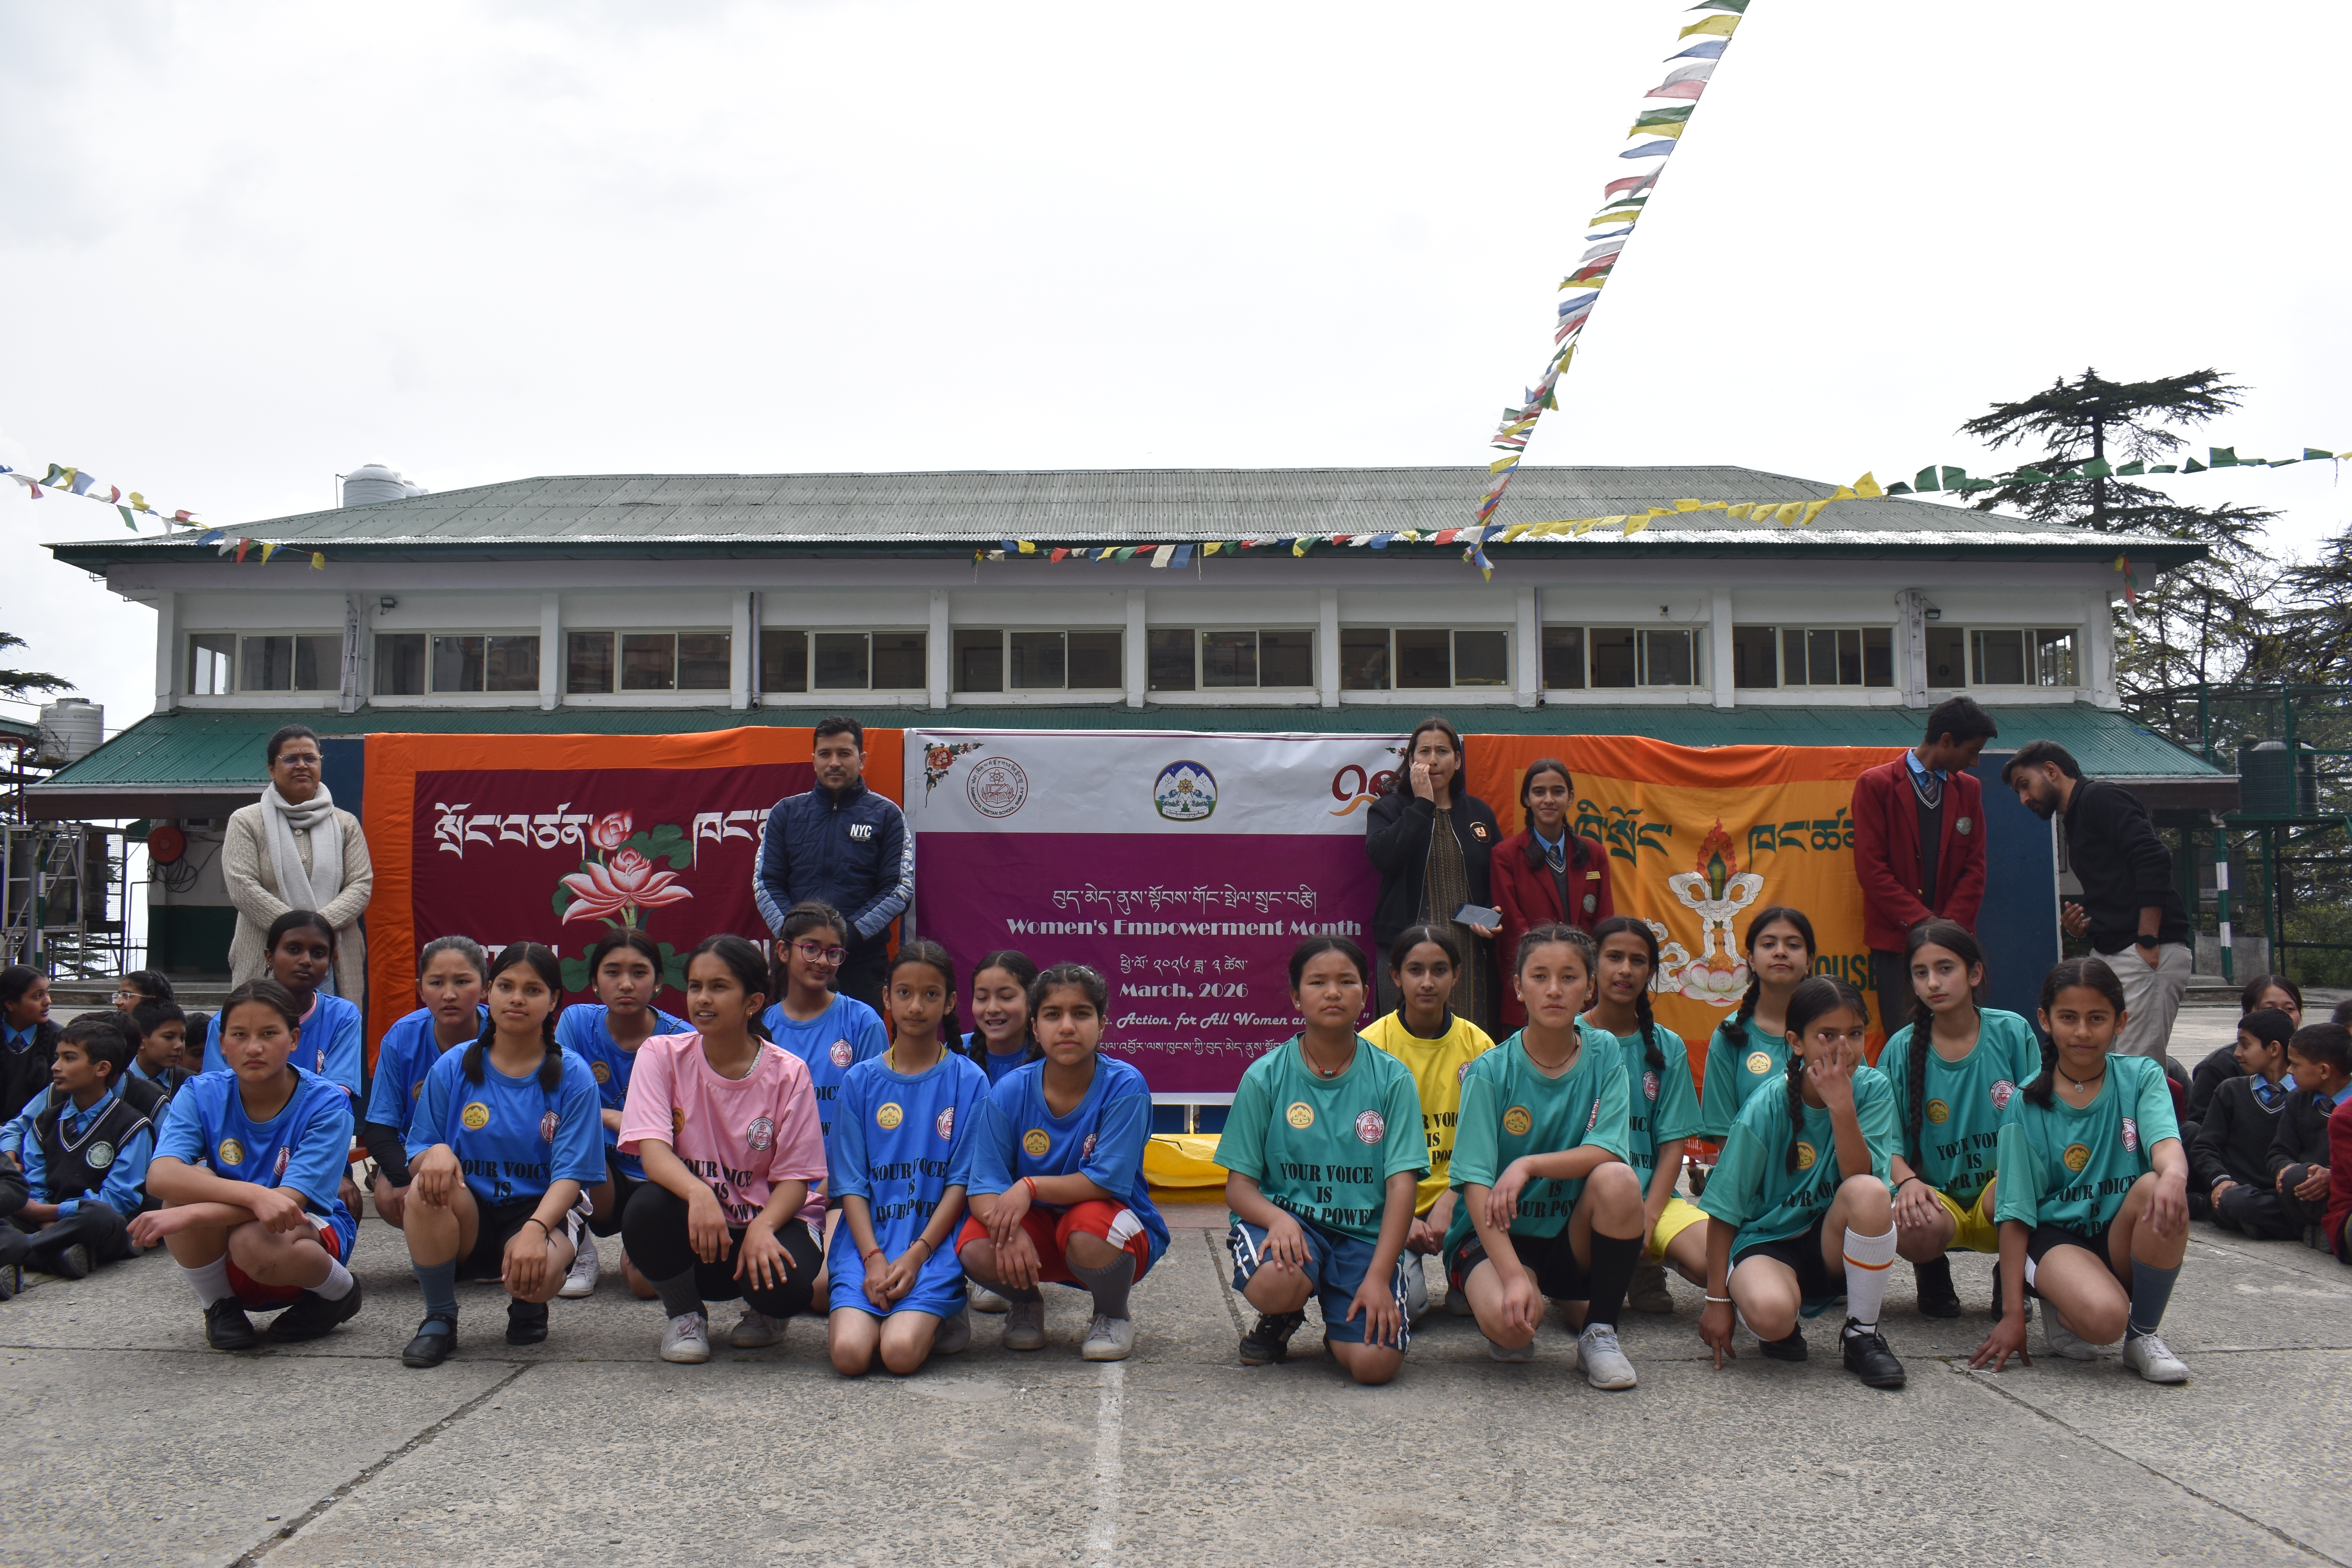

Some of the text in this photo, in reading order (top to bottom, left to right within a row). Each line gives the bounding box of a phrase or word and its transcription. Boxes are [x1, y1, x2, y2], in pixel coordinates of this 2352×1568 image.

[971, 786, 981, 808] SAMBHOTA
[982, 806, 998, 815] TIBETAN
[1015, 787, 1024, 806] SHIMLA-2
[850, 824, 872, 837] NYC
[1007, 918, 1361, 936] Women's Empowerment Month
[1813, 954, 1878, 991] OUSE
[1119, 983, 1249, 999] March, 2026
[1116, 1012, 1171, 1029] Action.
[1174, 1012, 1197, 1031] for
[1200, 1012, 1230, 1029] All
[1233, 1012, 1288, 1025] Women
[814, 1085, 840, 1100] OIC
[1433, 1112, 1458, 1128] VOI
[1426, 1132, 1440, 1147] IS
[460, 1159, 498, 1178] OUR
[1966, 1153, 1982, 1169] IS
[681, 1158, 753, 1187] OUR OICE
[871, 1162, 911, 1183] YOUR
[1280, 1163, 1374, 1184] YOUR VOICE
[493, 1181, 511, 1198] IS
[714, 1182, 730, 1199] IS
[1316, 1186, 1332, 1203] IS
[1548, 1181, 1563, 1198] IS
[2052, 1184, 2094, 1202] OUR
[1781, 1190, 1812, 1208] OUR
[1320, 1207, 1375, 1226] POWE
[1516, 1200, 1546, 1218] OUR
[2089, 1201, 2101, 1219] IS
